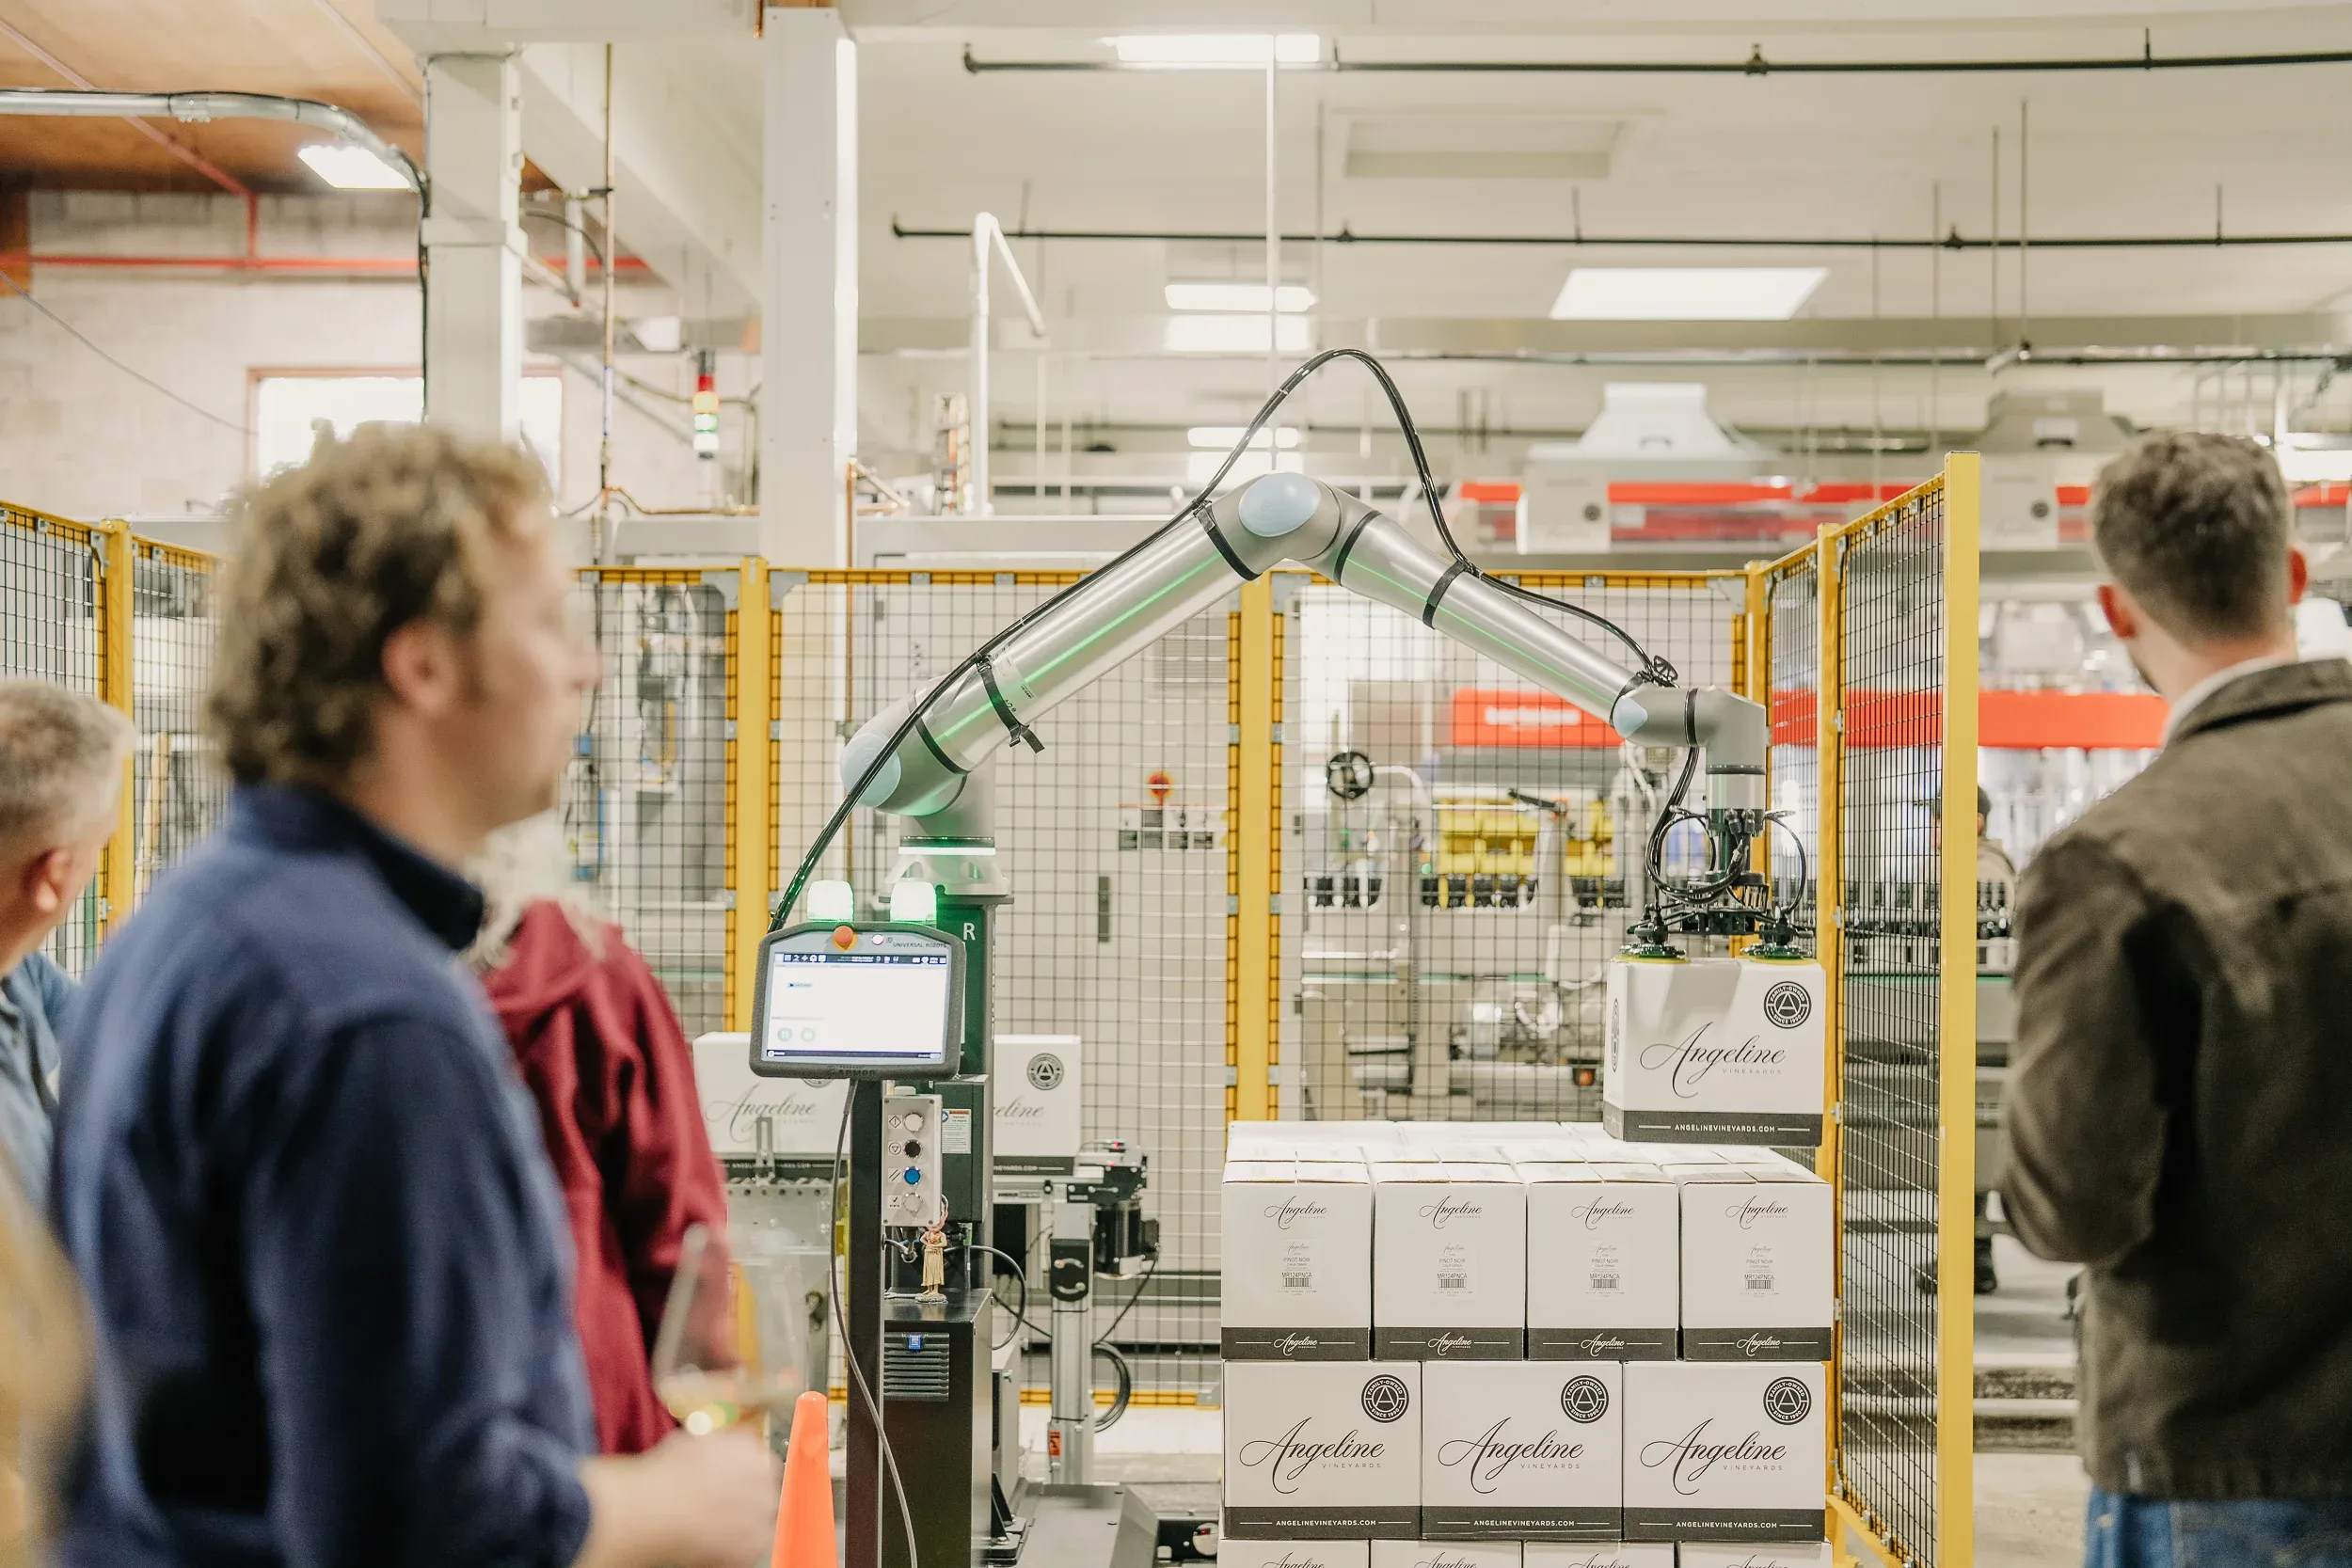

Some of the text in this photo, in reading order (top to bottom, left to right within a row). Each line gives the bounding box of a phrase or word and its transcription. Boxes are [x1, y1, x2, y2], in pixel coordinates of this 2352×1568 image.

[962, 922, 977, 941] R
[1640, 1021, 1787, 1099] Angeline
[706, 1083, 817, 1143] Angeline
[993, 1096, 1045, 1117] eline
[1675, 1124, 1775, 1133] ANGELINEVINEYARDS.COM
[1263, 1196, 1328, 1230] Angeline
[1419, 1195, 1483, 1230] Angeline
[1570, 1196, 1635, 1231] Angeline
[1724, 1195, 1789, 1230] Angeline
[1273, 1332, 1318, 1356] Angeline
[1427, 1331, 1472, 1356] Angeline
[1580, 1332, 1626, 1357] Angeline
[1736, 1332, 1781, 1357] Angeline
[1239, 1416, 1386, 1495] Angeline
[1438, 1417, 1584, 1495] Angeline
[1640, 1418, 1788, 1496] Angeline
